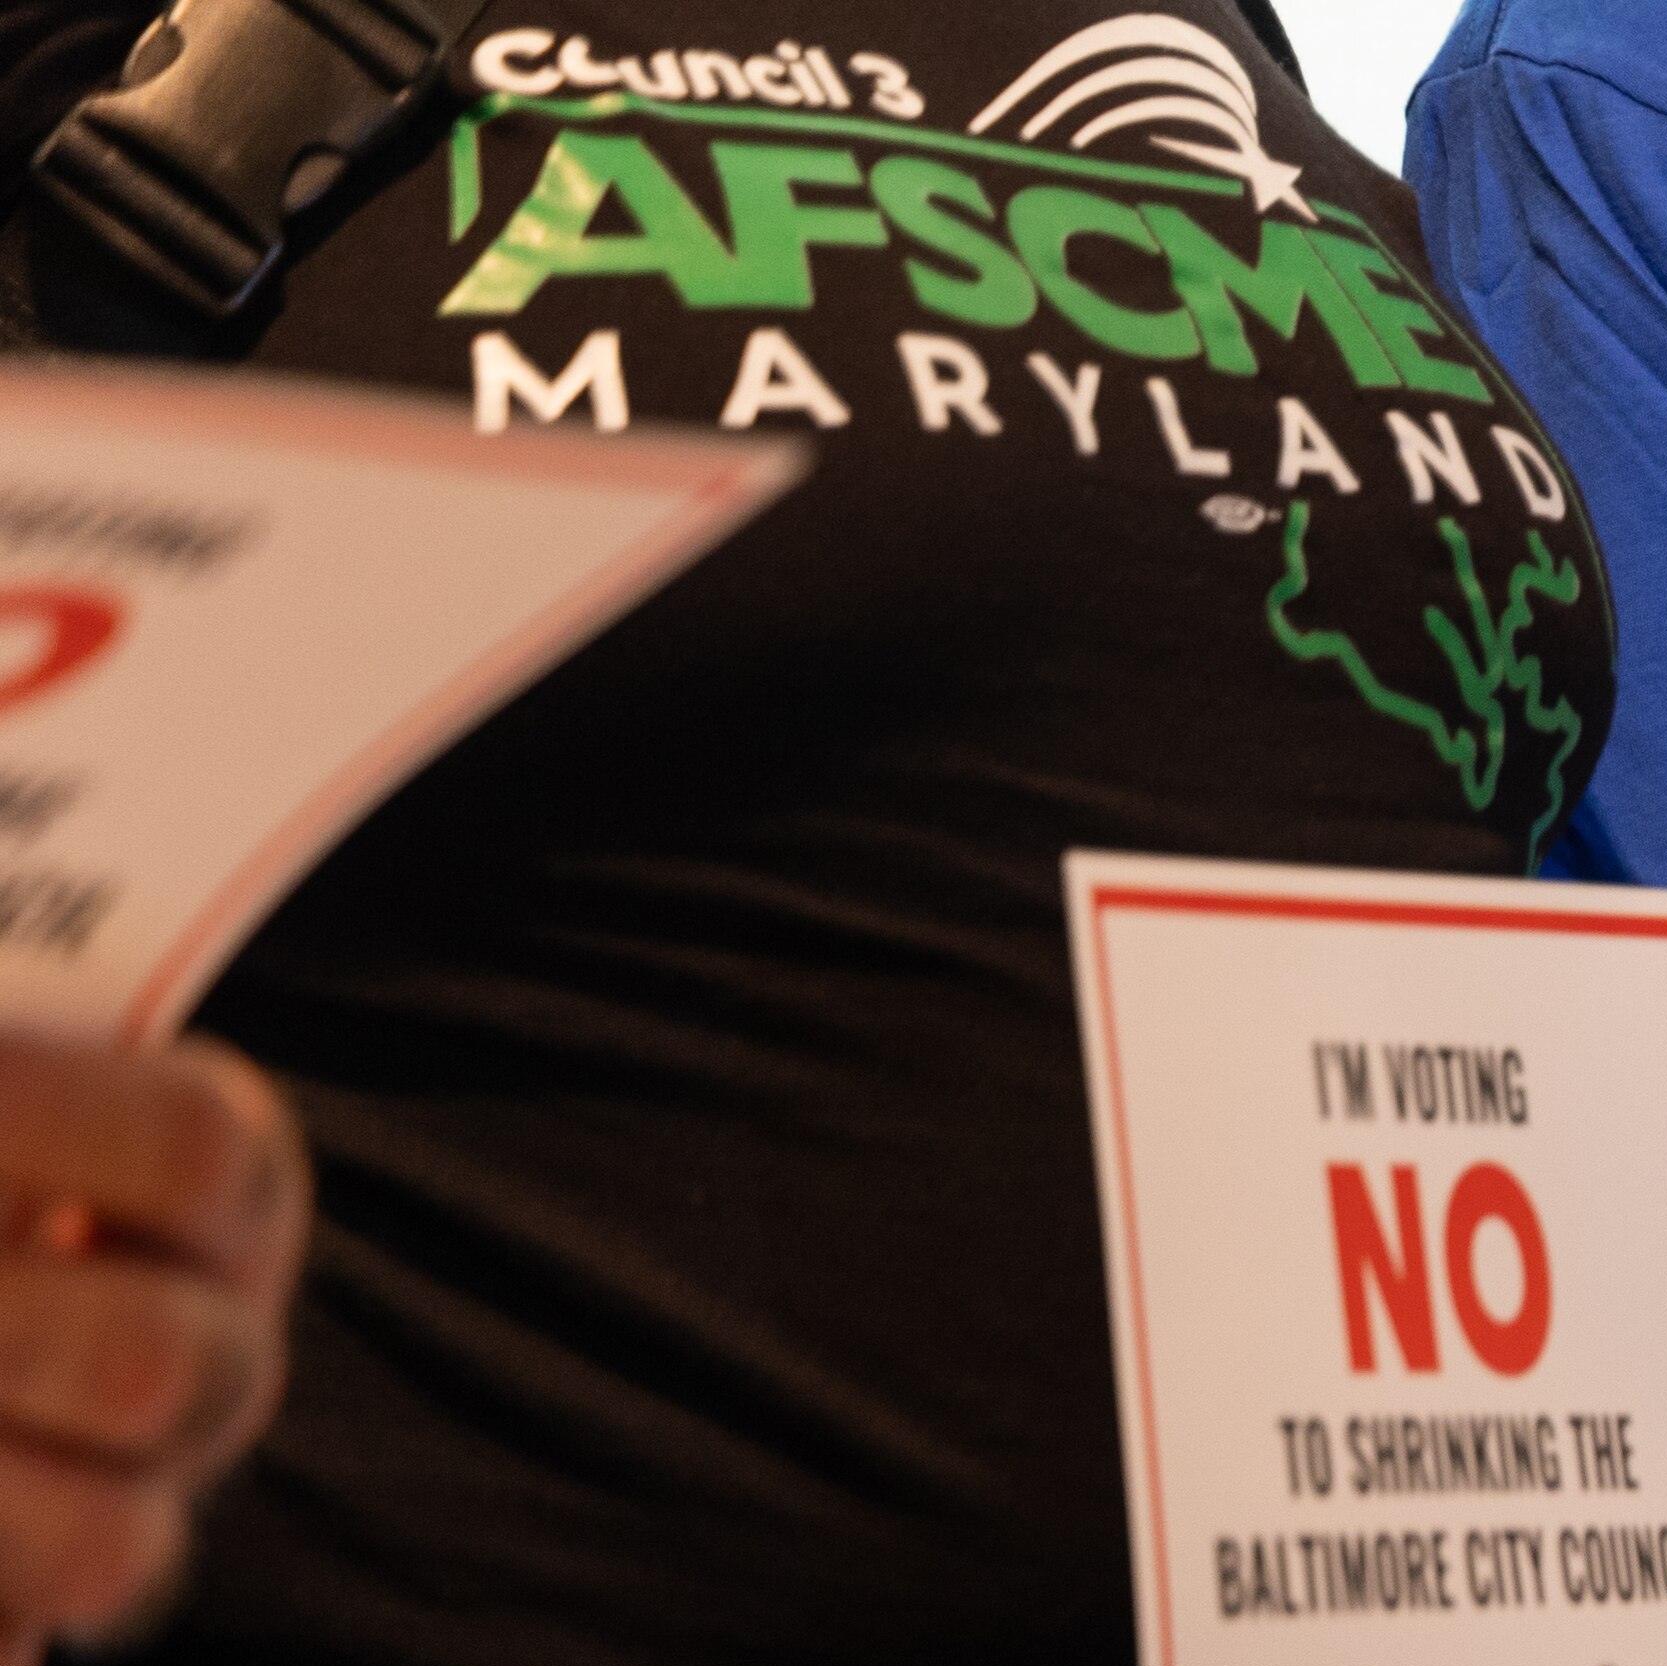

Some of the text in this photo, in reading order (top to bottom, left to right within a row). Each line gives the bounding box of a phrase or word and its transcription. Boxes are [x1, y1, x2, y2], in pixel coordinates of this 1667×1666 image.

[438, 130, 1495, 403] AFSCME
[471, 327, 1566, 521] MARYLAND
[1313, 1041, 1529, 1125] I'M VOTING
[1325, 1159, 1553, 1377] NO
[1278, 1413, 1640, 1499] TO SHRINKING THE
[1214, 1530, 1455, 1620] BALTIMORE
[1465, 1525, 1548, 1608] CITY
